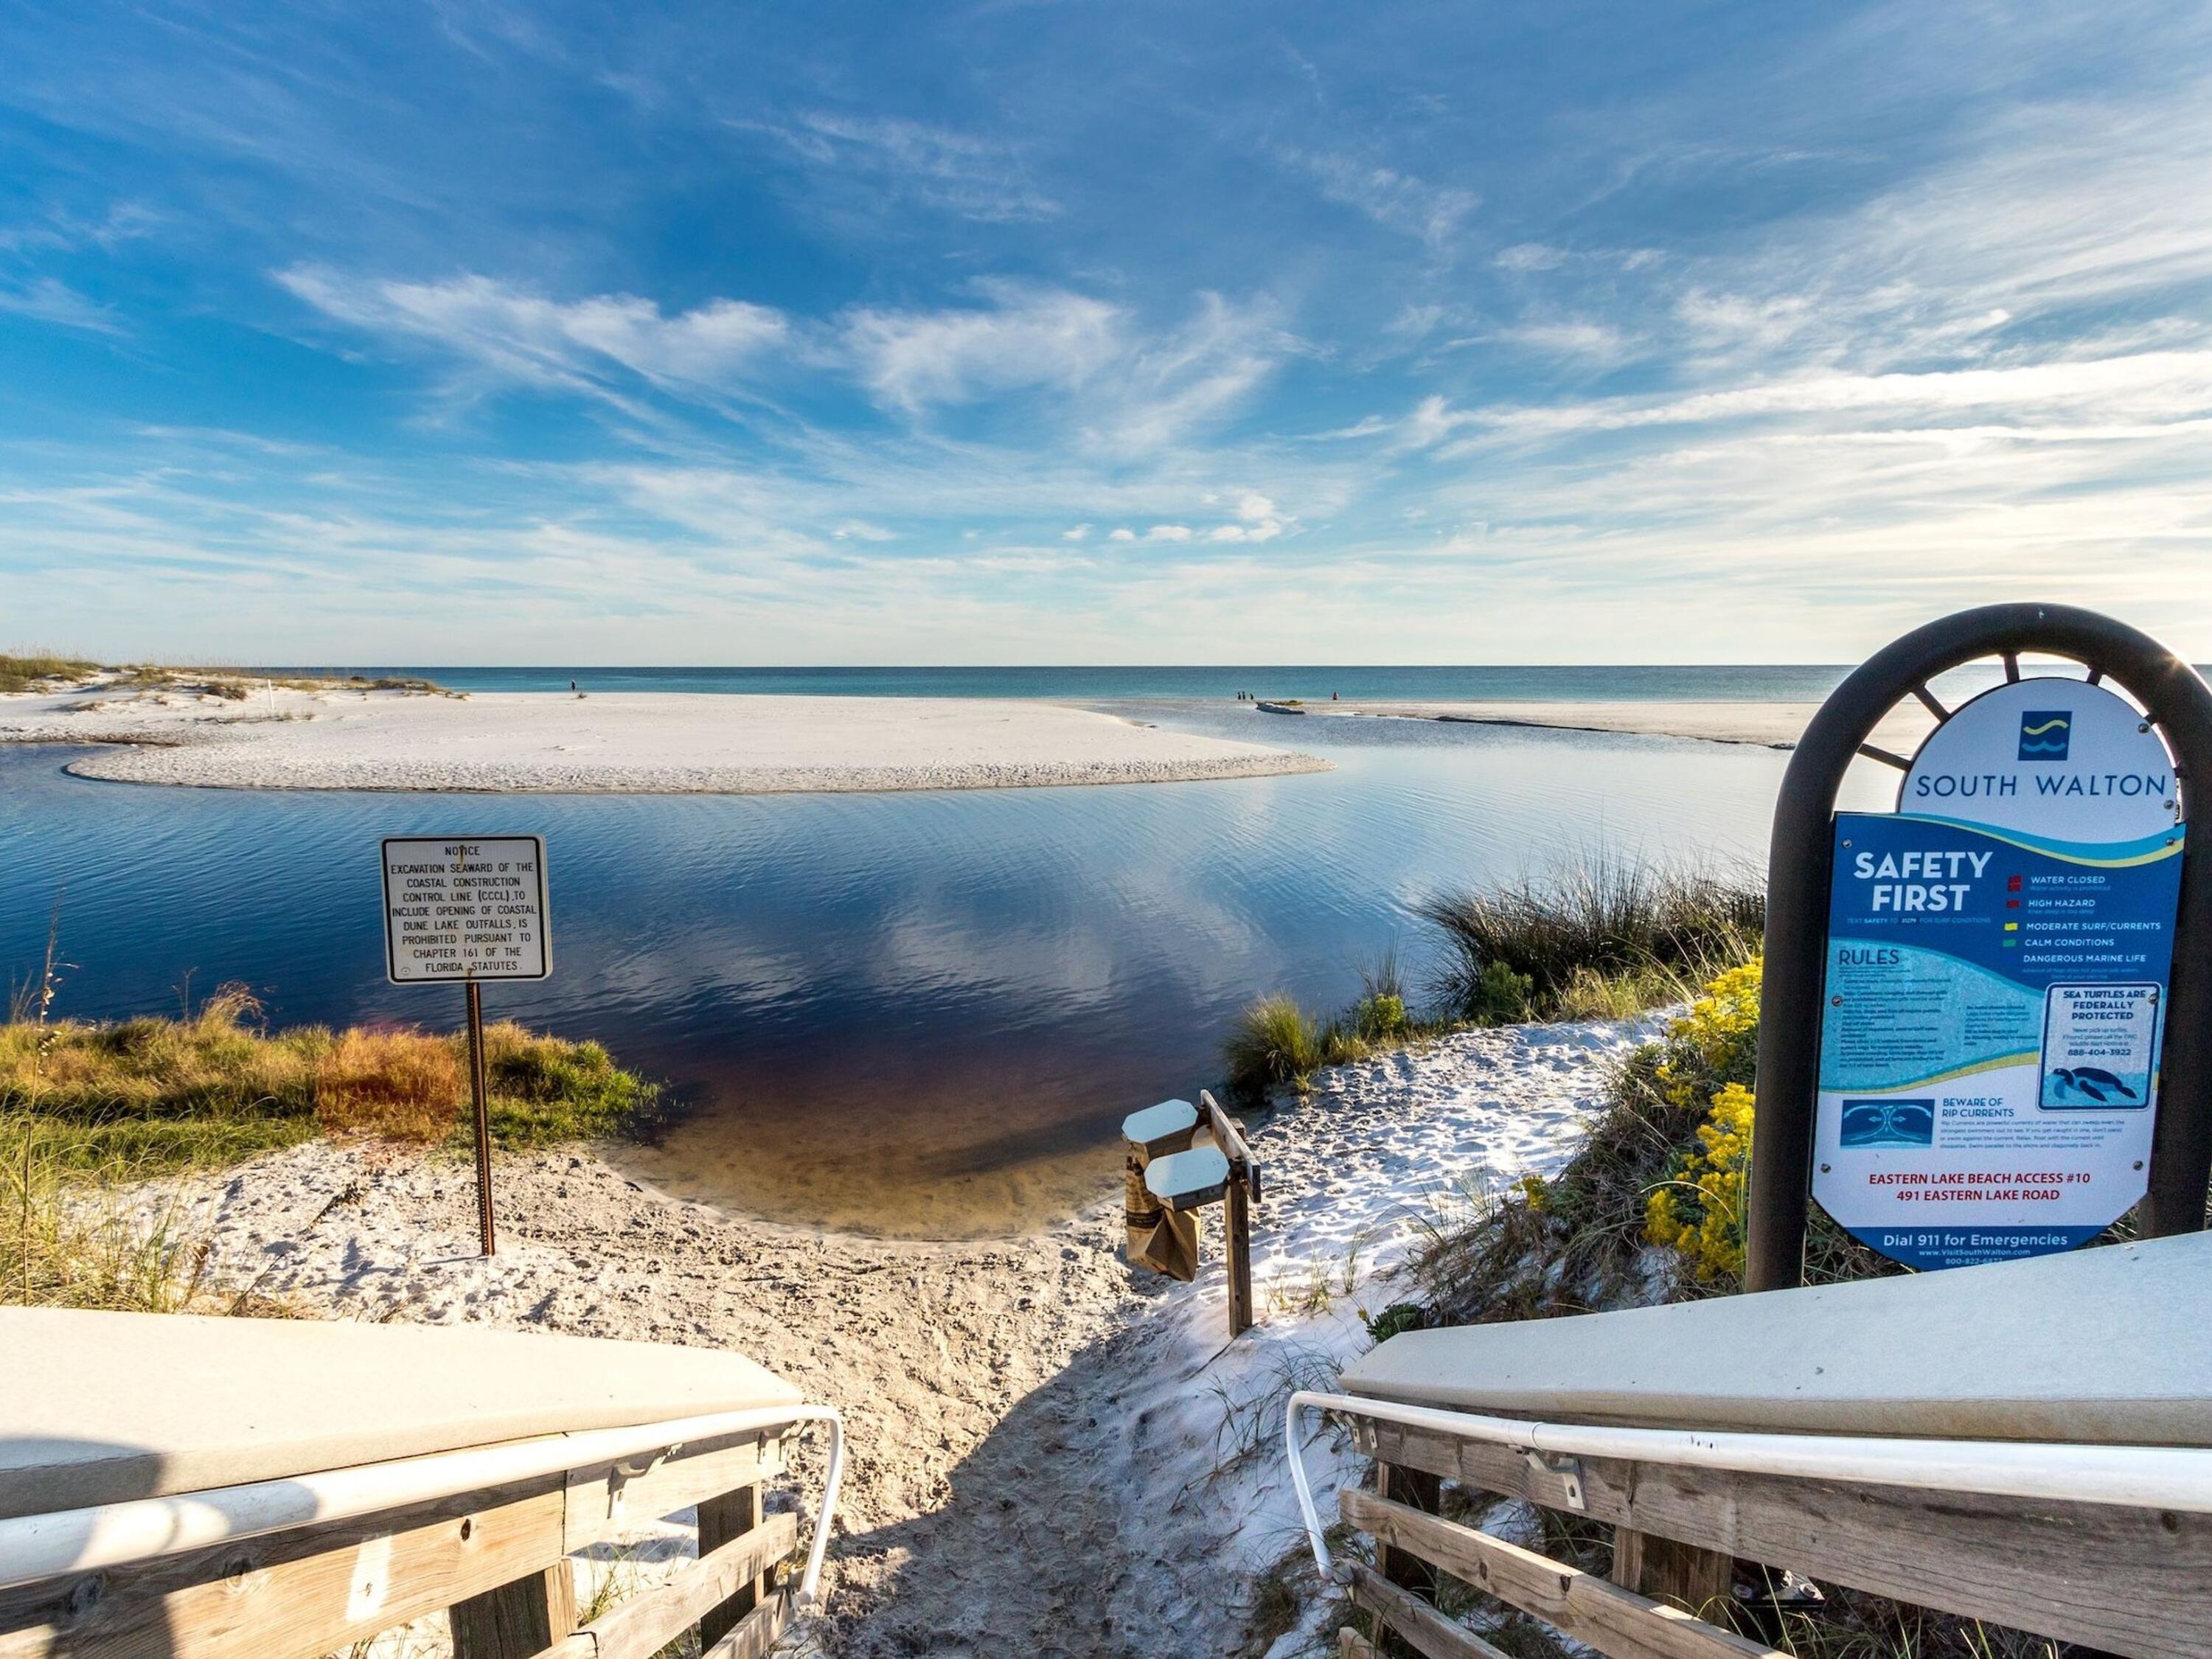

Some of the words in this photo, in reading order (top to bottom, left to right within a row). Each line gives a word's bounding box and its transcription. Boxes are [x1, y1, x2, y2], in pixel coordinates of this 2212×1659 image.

[1916, 775, 2017, 796] SOUTH
[2035, 775, 2166, 796] WALTON
[445, 846, 480, 855] NOTICE
[391, 864, 445, 874] EXCAVATION
[450, 863, 493, 872] SEAWARD
[498, 863, 510, 872] OF
[516, 863, 534, 872] THE
[1854, 852, 1994, 879] SAFETY
[407, 878, 447, 888] COASTAL
[453, 877, 521, 887] CONSTRUCTION
[2031, 875, 2065, 884] WATER
[2067, 875, 2106, 884] CLOSED
[403, 892, 445, 902] CONTROL
[451, 891, 473, 901] LINE
[514, 891, 525, 900] TO
[1872, 885, 1970, 911] FIRST
[392, 907, 430, 917] INCLUDE
[437, 906, 476, 916] OPENING
[481, 905, 493, 914] OF
[498, 905, 537, 914] COASTAL
[403, 921, 428, 931] DUNE
[435, 920, 459, 930] LAKE
[519, 919, 527, 928] IS
[2026, 922, 2079, 931] MODERATE
[2081, 922, 2160, 931] SURF/CURRENTS
[403, 935, 456, 945] PROHIBITED
[465, 933, 512, 944] PURSUANT
[520, 933, 531, 942] TO
[2025, 939, 2051, 947] CALM
[414, 949, 456, 959] CHAPTER
[464, 948, 478, 957] 161
[485, 947, 498, 956] OF
[505, 947, 521, 956] THE
[1839, 949, 1899, 965] RULES
[2023, 954, 2083, 962] DANGEROUS
[2085, 954, 2123, 962] MARINE
[2126, 954, 2146, 962] LIFE
[425, 962, 463, 972] FLORIDA
[2063, 990, 2081, 998] SEA
[2084, 990, 2125, 998] TURTLES
[2126, 990, 2146, 998] ARE
[2073, 1001, 2135, 1009] FEDERALLY
[2072, 1012, 2134, 1020] PROTECTED
[1943, 1098, 1986, 1107] BEWARE
[1988, 1098, 2003, 1107] OF
[1942, 1108, 1958, 1118] RIP
[1960, 1108, 2014, 1118] CURRENTS
[1869, 1174, 1928, 1184] EASTERN
[1932, 1174, 1964, 1184] LAKE
[1968, 1173, 2011, 1184] BEACH
[2014, 1173, 2063, 1183] ACCESS
[2067, 1173, 2090, 1183] #10
[1896, 1191, 1919, 1201] 491
[1924, 1191, 1982, 1200] EASTERN
[1986, 1190, 2018, 1200] LAKE
[2022, 1190, 2060, 1200] ROAD
[1884, 1234, 1912, 1246] Dial
[1918, 1234, 1939, 1246] 911
[1944, 1234, 1966, 1245] for
[1971, 1234, 2067, 1248] Emergencies
[1919, 1248, 2031, 1256] www.VisitSouthWalton.com
